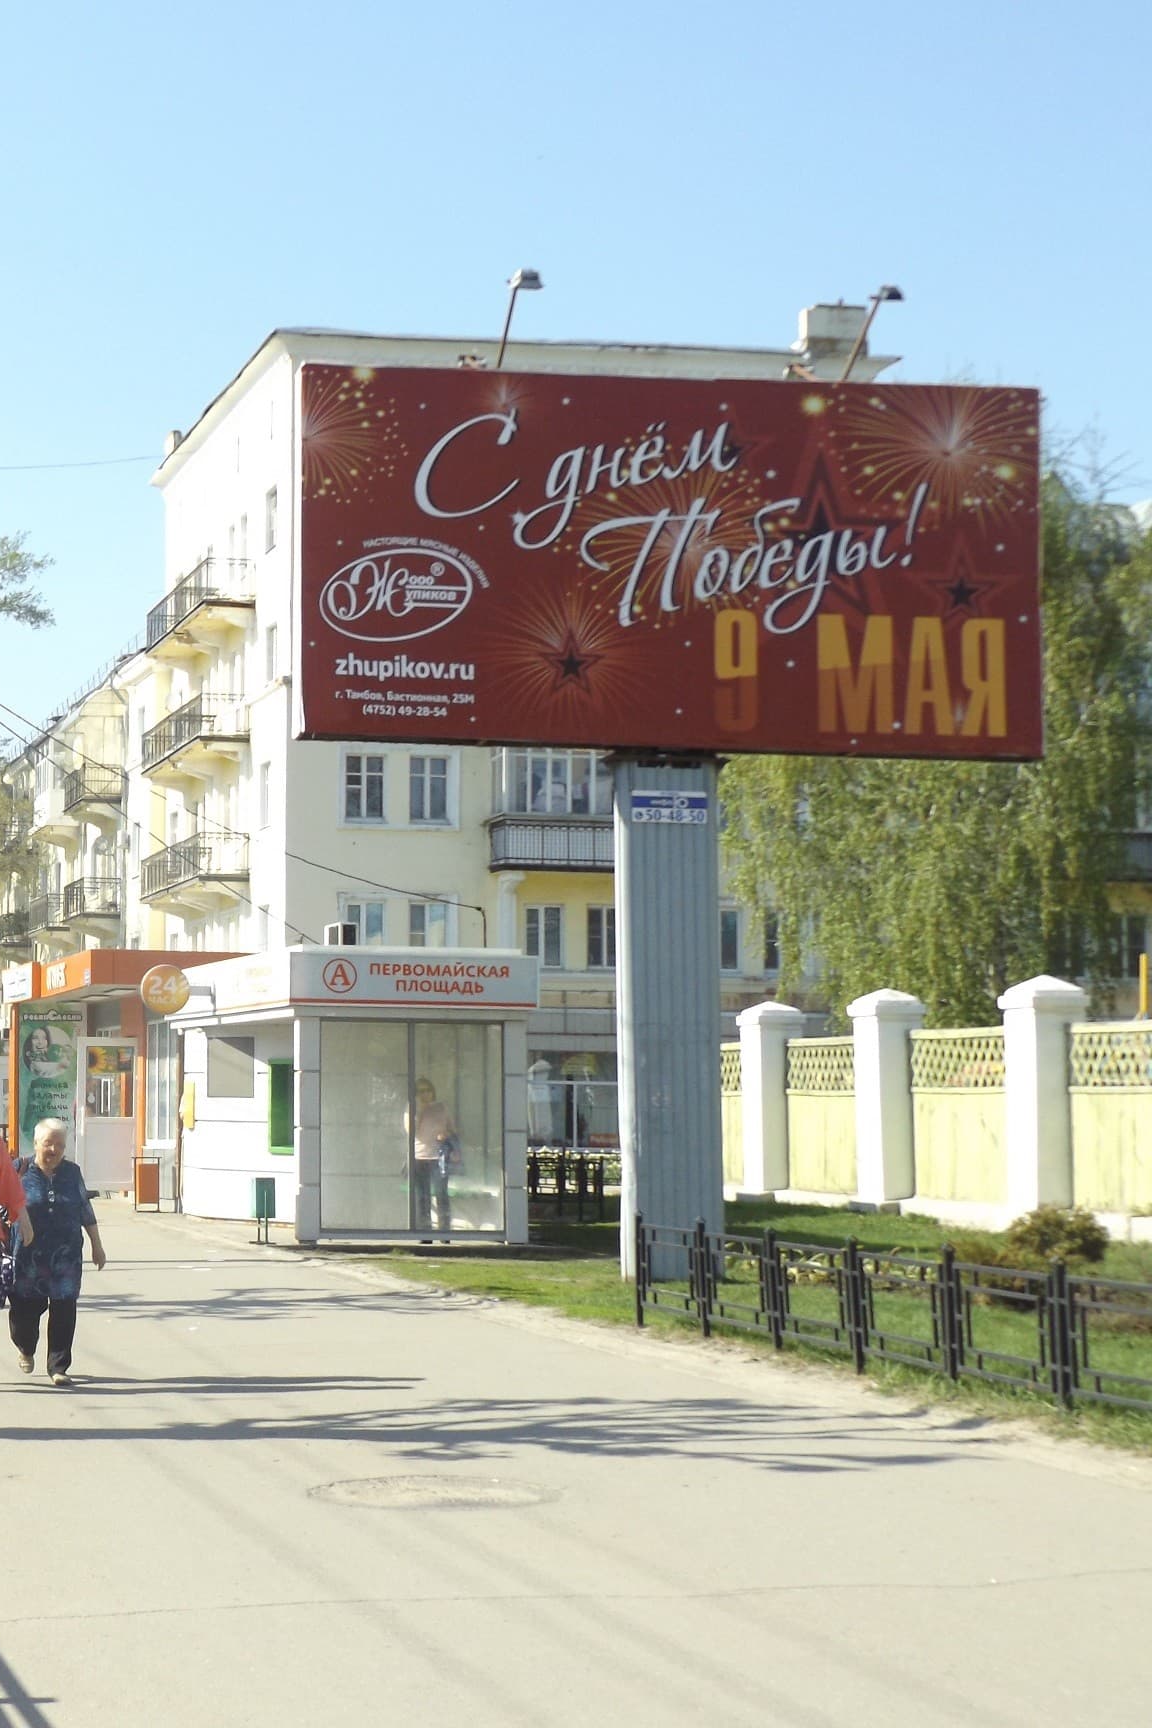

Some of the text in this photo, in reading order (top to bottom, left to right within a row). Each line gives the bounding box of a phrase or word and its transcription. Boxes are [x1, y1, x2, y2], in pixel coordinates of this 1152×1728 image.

[413, 407, 738, 550] С днём
[580, 481, 929, 634] Победы!
[335, 652, 475, 682] zhupikov.ru
[713, 608, 1008, 737] 9 МАЯ
[345, 689, 385, 702] Тамбов,
[387, 691, 450, 704] Бастионная,
[362, 704, 448, 717] (4752) 49-28-54
[369, 962, 510, 978] ПЕРВОМАЙСКАЯ
[149, 975, 177, 995] 24
[395, 980, 485, 995] ПЛОЩАДЬ
